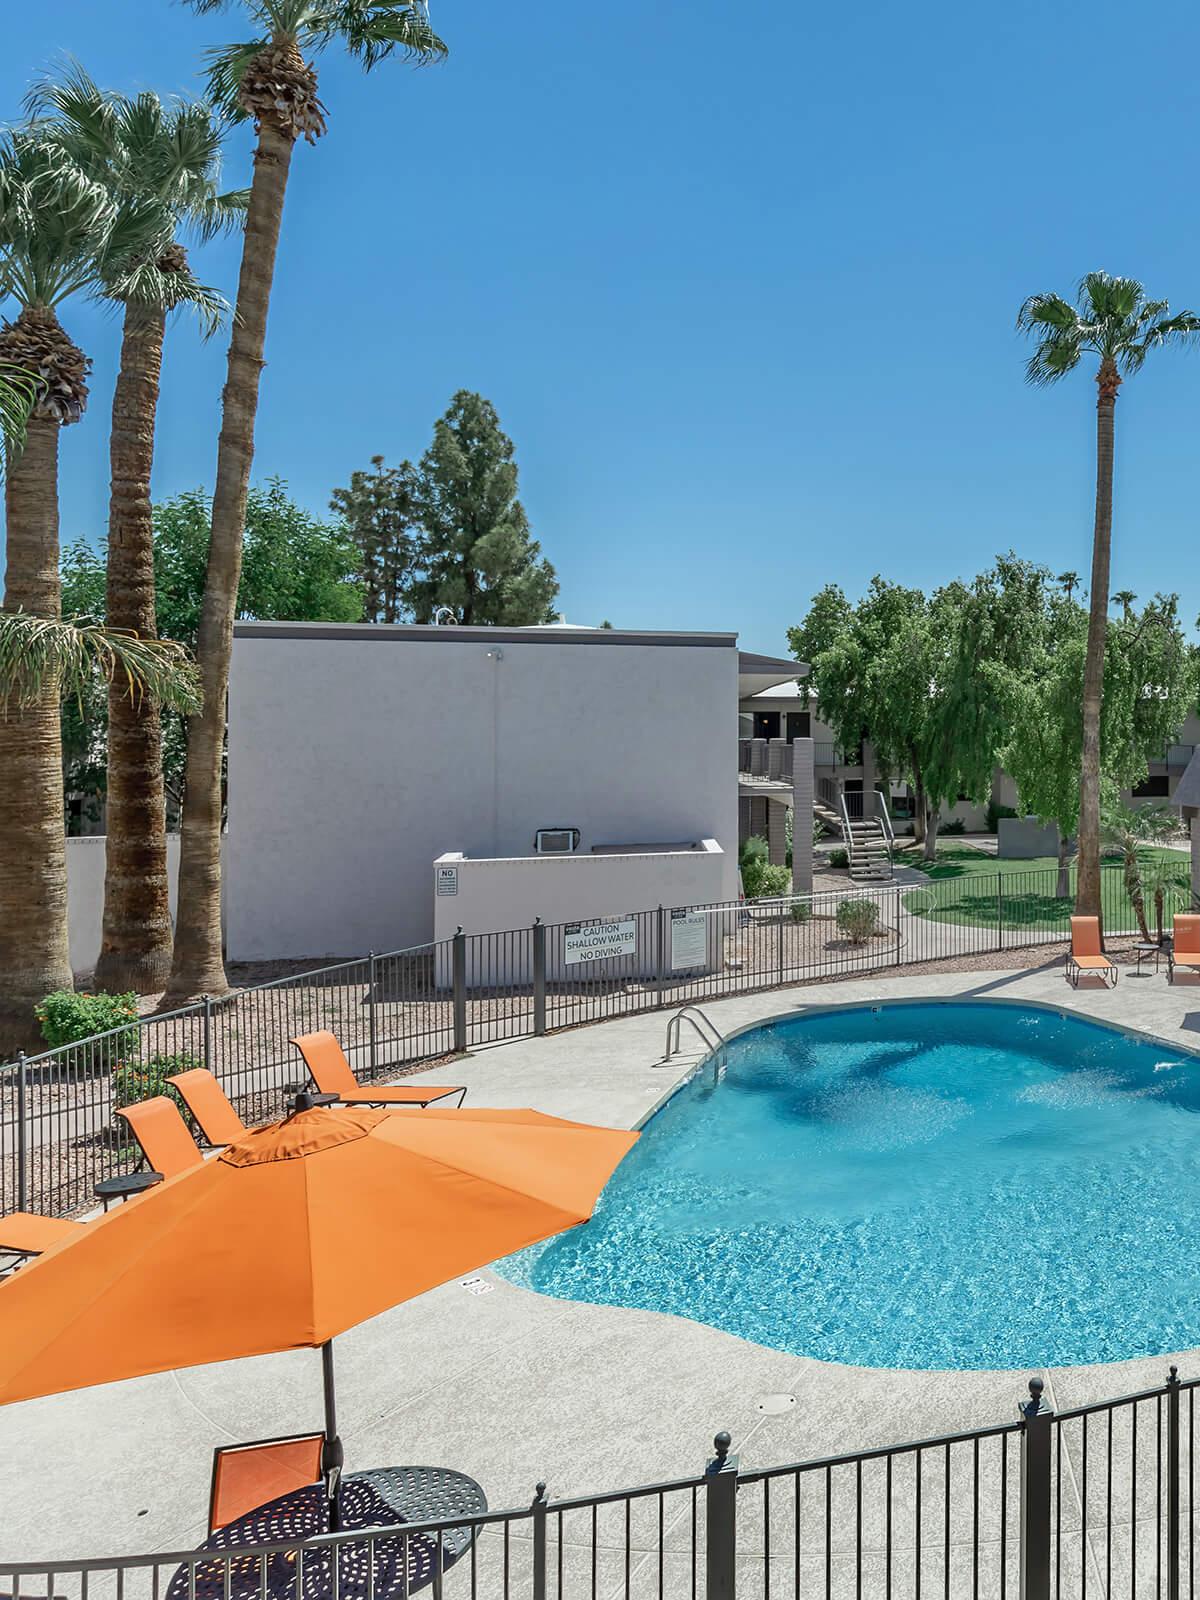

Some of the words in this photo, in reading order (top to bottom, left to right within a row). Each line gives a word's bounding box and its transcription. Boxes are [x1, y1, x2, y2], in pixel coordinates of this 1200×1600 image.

[583, 924, 620, 937] CAUTION
[567, 936, 607, 950] SHALLOW
[607, 932, 634, 943] WATER
[580, 951, 593, 960] NO
[594, 946, 623, 958] DIVING
